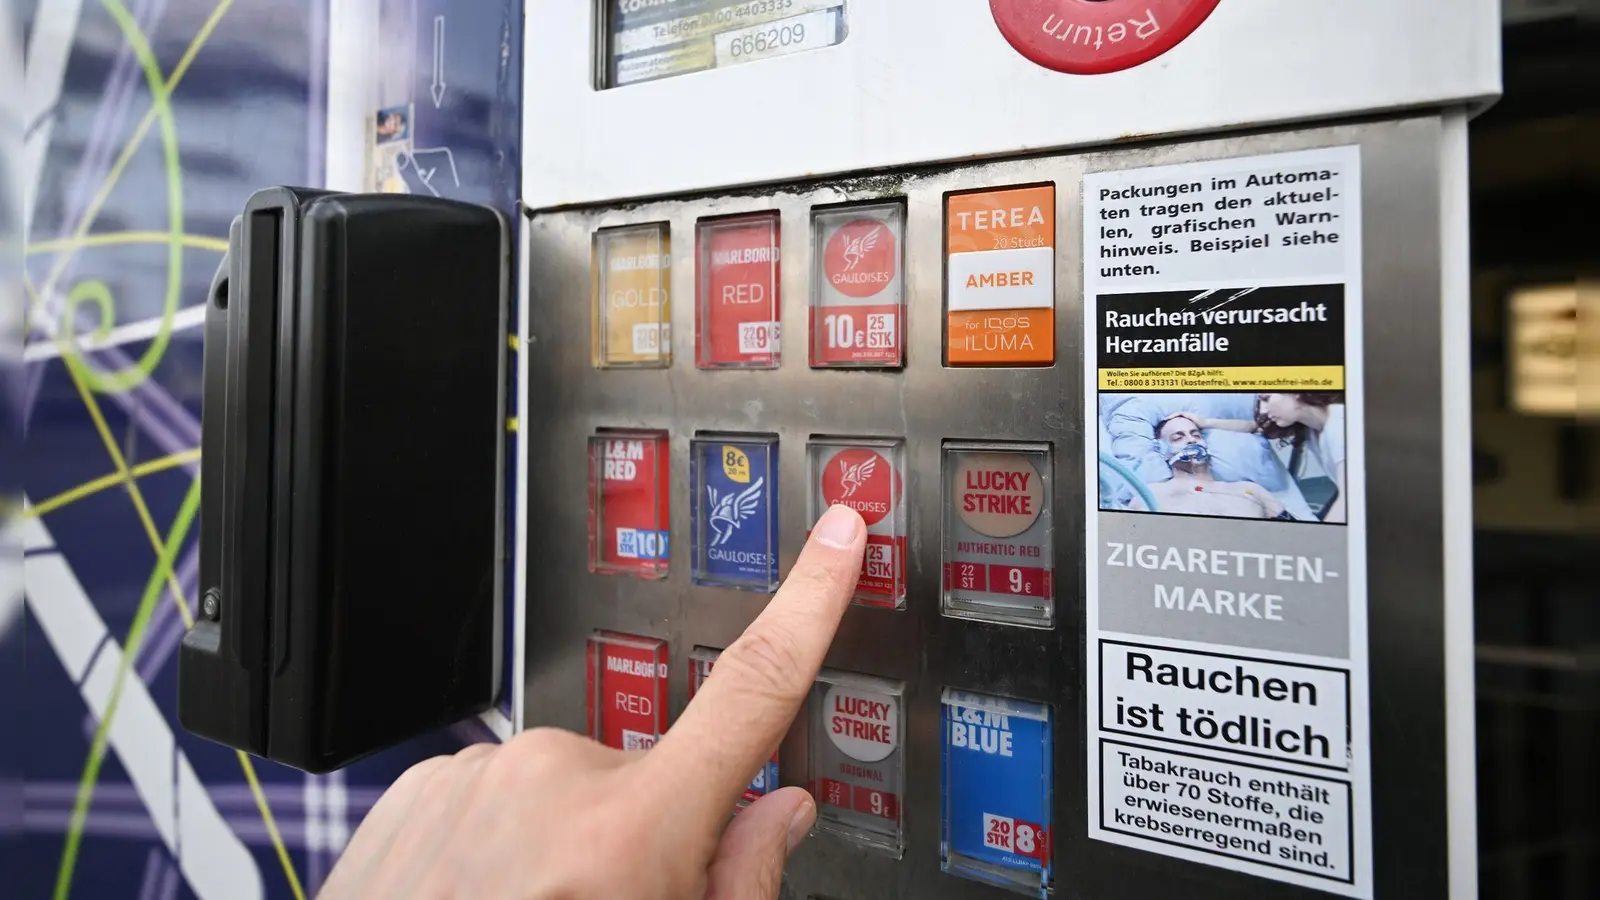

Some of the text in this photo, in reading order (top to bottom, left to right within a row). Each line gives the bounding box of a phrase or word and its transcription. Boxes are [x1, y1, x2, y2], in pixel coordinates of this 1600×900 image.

[653, 18, 698, 38] Telefon
[1042, 9, 1160, 50] Return
[730, 23, 805, 57] 666209
[1100, 169, 1339, 202] Packungen im Automa-
[1100, 187, 1339, 220] ten tragen den aktuel-
[957, 205, 1044, 231] TEREA
[1100, 210, 1339, 239] len, grafischen Warn-
[992, 238, 1008, 250] 20
[1100, 230, 1339, 258] hinweis. Beispiel siehe
[832, 271, 889, 284] GAULOISES
[966, 271, 1034, 289] AMBER
[1100, 263, 1160, 278] unten.
[612, 288, 668, 308] GOLD
[722, 283, 764, 305] RED
[870, 316, 885, 329] 25
[965, 317, 1030, 330] for IQOS
[1105, 302, 1328, 328] Rauchen verursacht
[869, 331, 892, 346] STK
[964, 334, 1034, 351] ILUMA
[1105, 332, 1230, 353] Herzanfälle
[1107, 379, 1122, 387] Tel.:
[1124, 379, 1143, 387] 0800
[1144, 379, 1150, 387] 8
[1180, 378, 1231, 388] (kostenfrei),
[1232, 378, 1333, 386] www.rauchfrei-info.de
[605, 440, 643, 461] L&M
[604, 460, 637, 480] RED
[966, 470, 1031, 492] LUCKY
[963, 494, 1032, 515] STRIKE
[868, 545, 883, 560] 25
[957, 541, 1041, 557] AUTHENTIC RED
[869, 561, 890, 577] STK
[961, 564, 974, 577] 22
[1106, 542, 1339, 583] ZIGARETTEN-
[962, 577, 975, 589] ST
[1153, 584, 1284, 621] MARKE
[1126, 651, 1317, 706] Rauchen
[615, 691, 652, 716] RED
[835, 695, 891, 721] LUCKY
[952, 704, 1011, 730] L&M
[1116, 696, 1330, 759] ist tödlich
[832, 716, 891, 745] STRIKE
[952, 720, 1013, 757] BLUE
[840, 762, 884, 783] ORIGINAL
[1117, 751, 1330, 805] Tabakrauch enthält
[829, 781, 841, 794] 22
[1123, 772, 1324, 824] über 70 Stoffe, die
[829, 794, 841, 806] ST
[990, 818, 1011, 835] 20
[1124, 794, 1322, 846] erwiesenermaßen
[986, 832, 1010, 848] STK
[1114, 808, 1336, 870] krebserregend sind.
